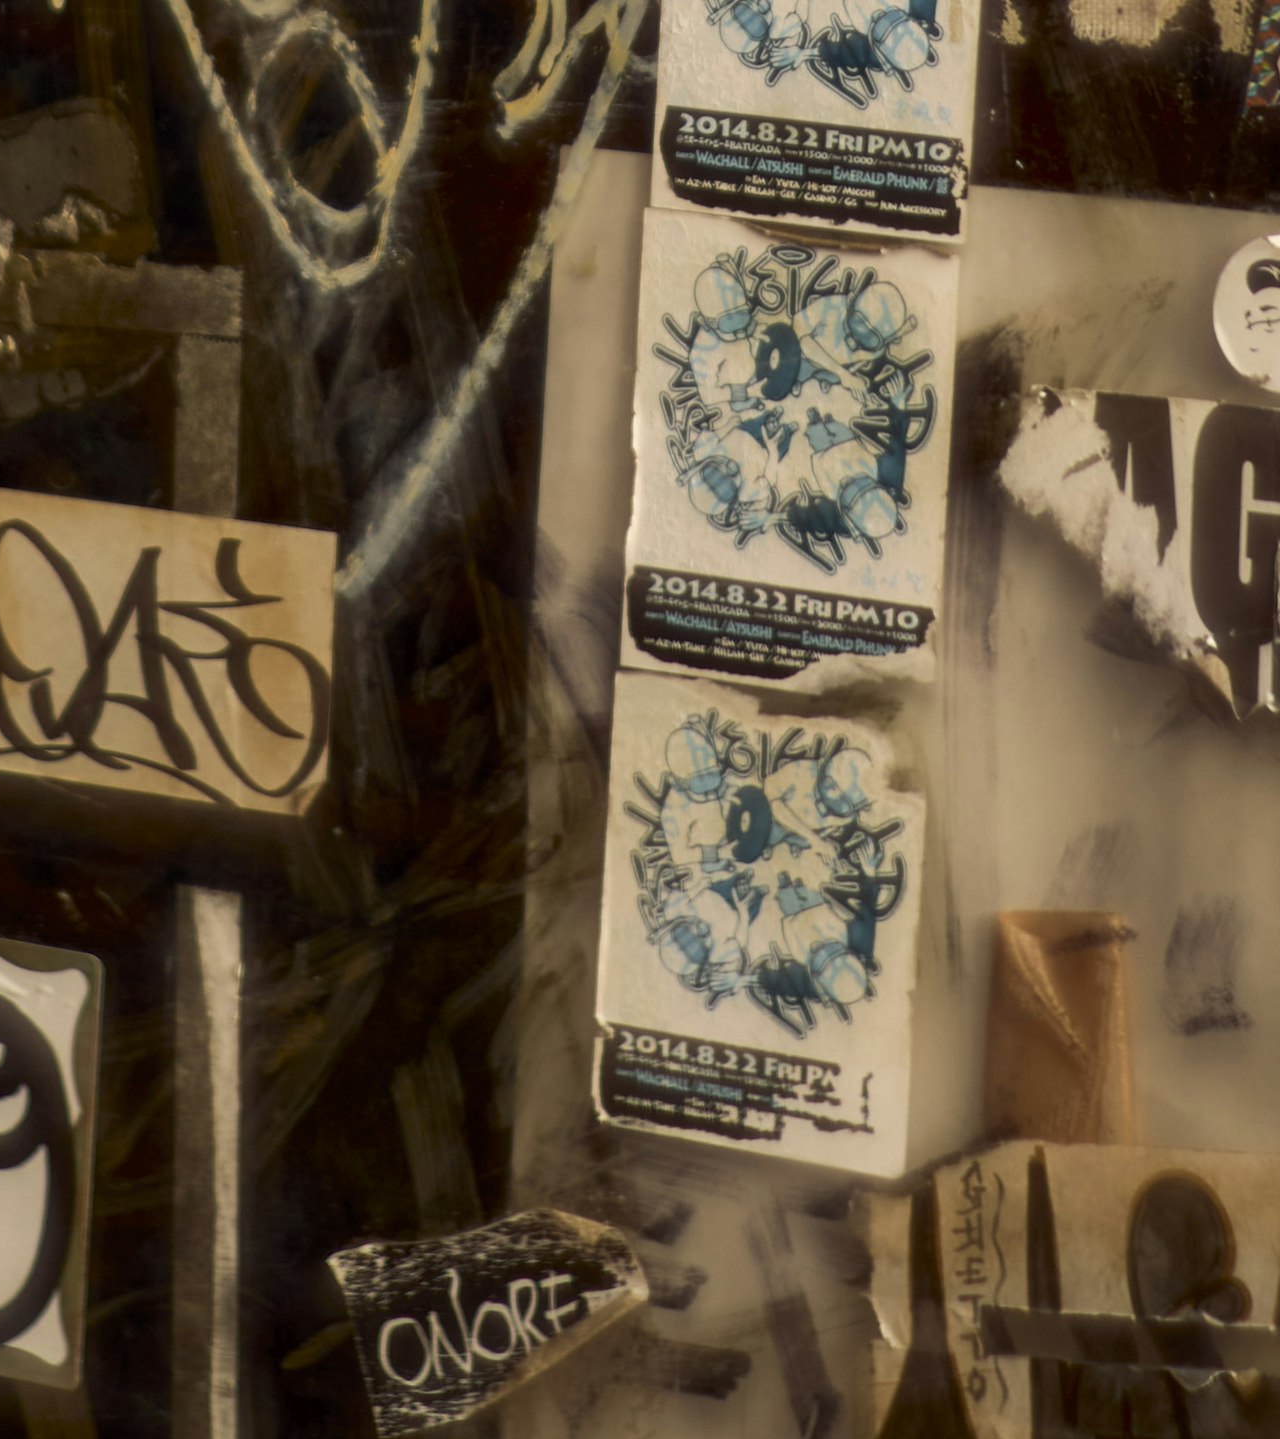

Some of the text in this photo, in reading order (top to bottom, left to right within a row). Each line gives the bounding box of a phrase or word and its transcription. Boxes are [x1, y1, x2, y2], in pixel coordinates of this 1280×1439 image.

[679, 112, 818, 148] 2014.8.22
[825, 129, 864, 153] FRI
[868, 133, 911, 160] PM
[913, 139, 952, 161] 10
[832, 165, 885, 185] EMERALD
[886, 171, 929, 190] PHUNK
[648, 572, 920, 629] 2014.8.22 FRI PM 10
[801, 629, 855, 651] EMERALD
[616, 1029, 759, 1074] 2014.8.22
[763, 1057, 802, 1082] FRI
